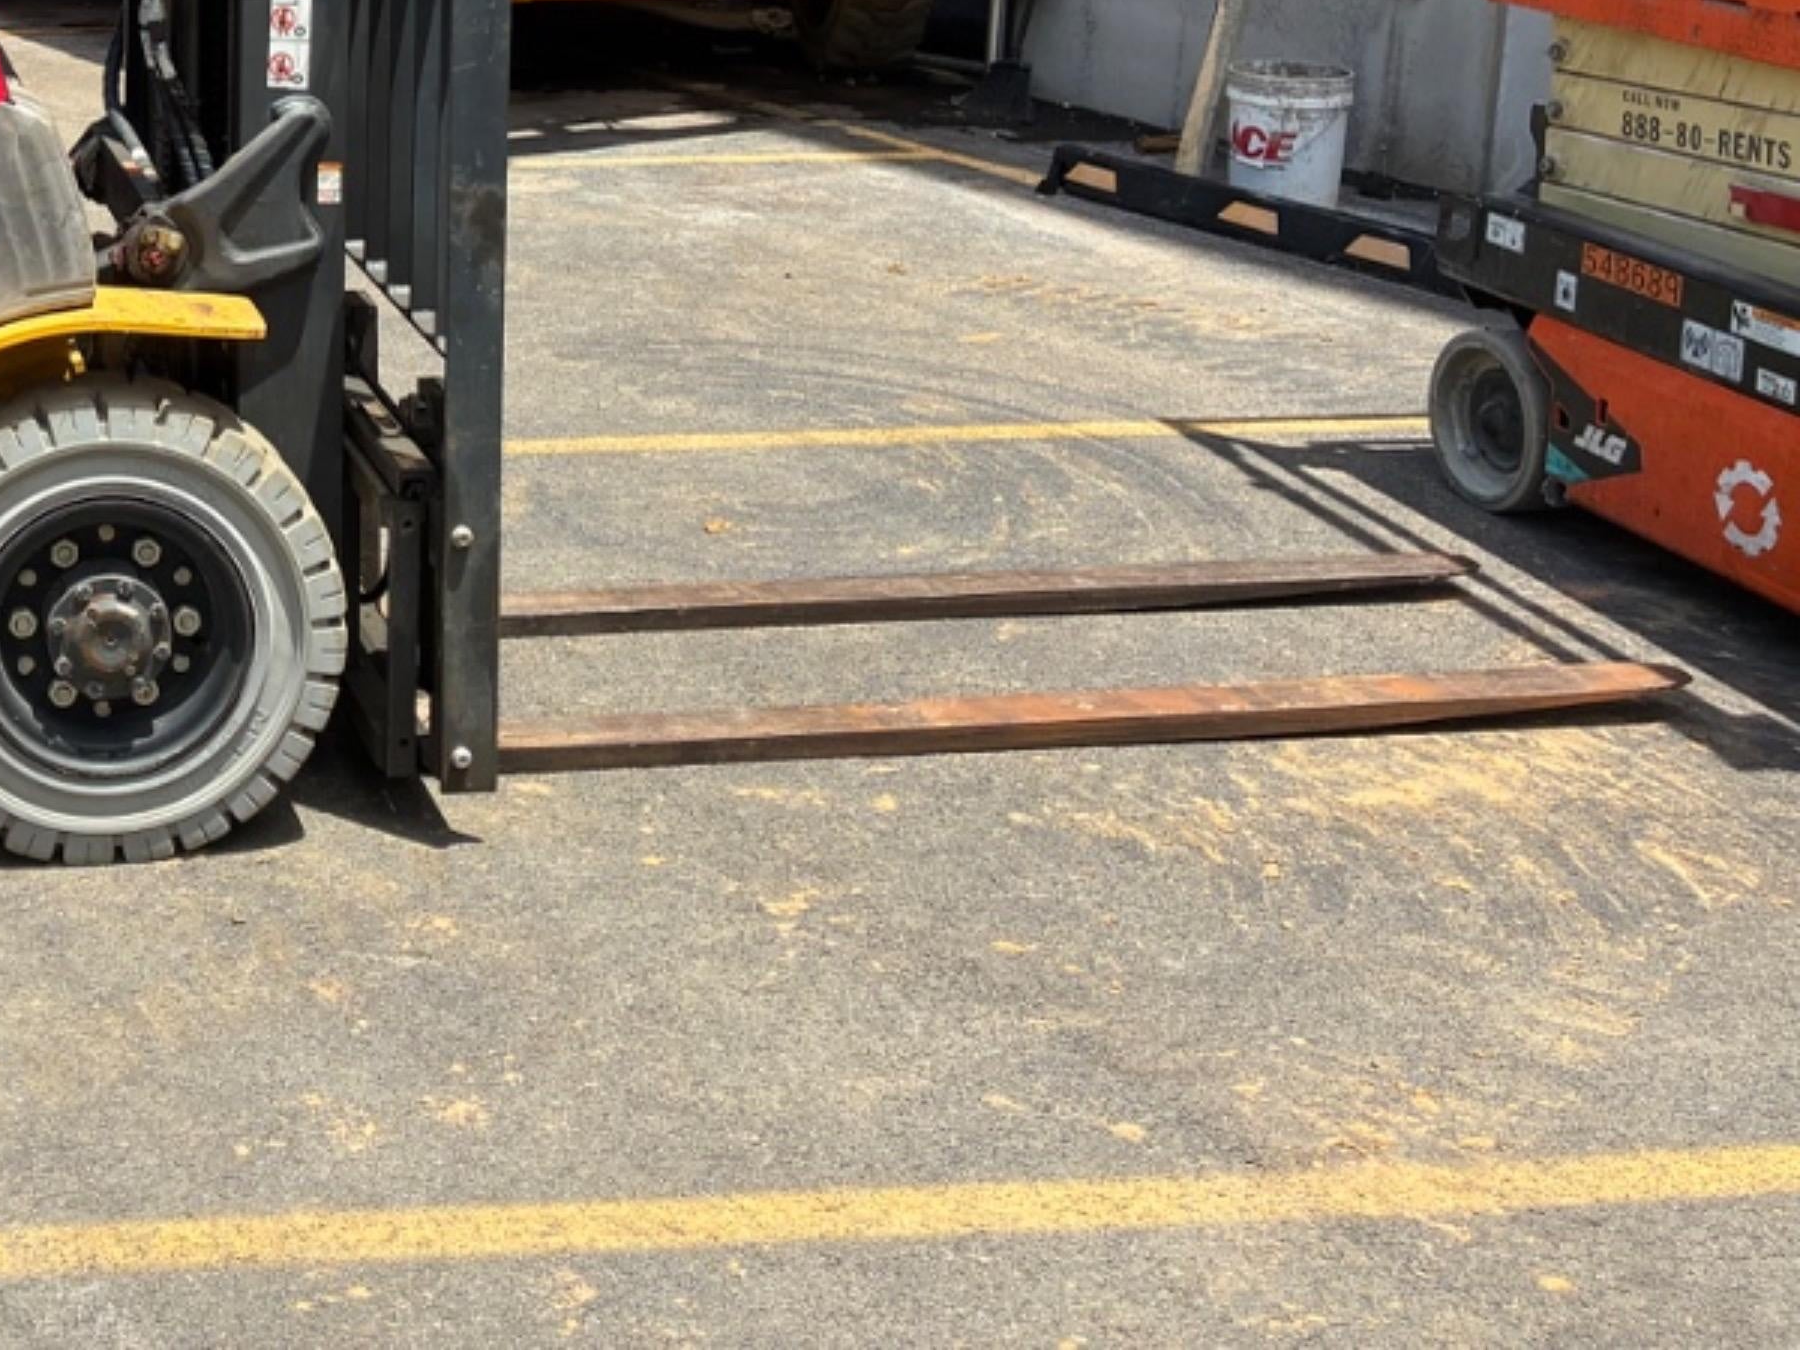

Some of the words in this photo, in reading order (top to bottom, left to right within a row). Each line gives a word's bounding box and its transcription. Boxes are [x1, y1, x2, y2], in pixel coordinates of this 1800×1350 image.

[1621, 110, 1792, 170] 888-80-RENTS
[1584, 244, 1679, 303] 548689
[1573, 423, 1627, 465] JLG
